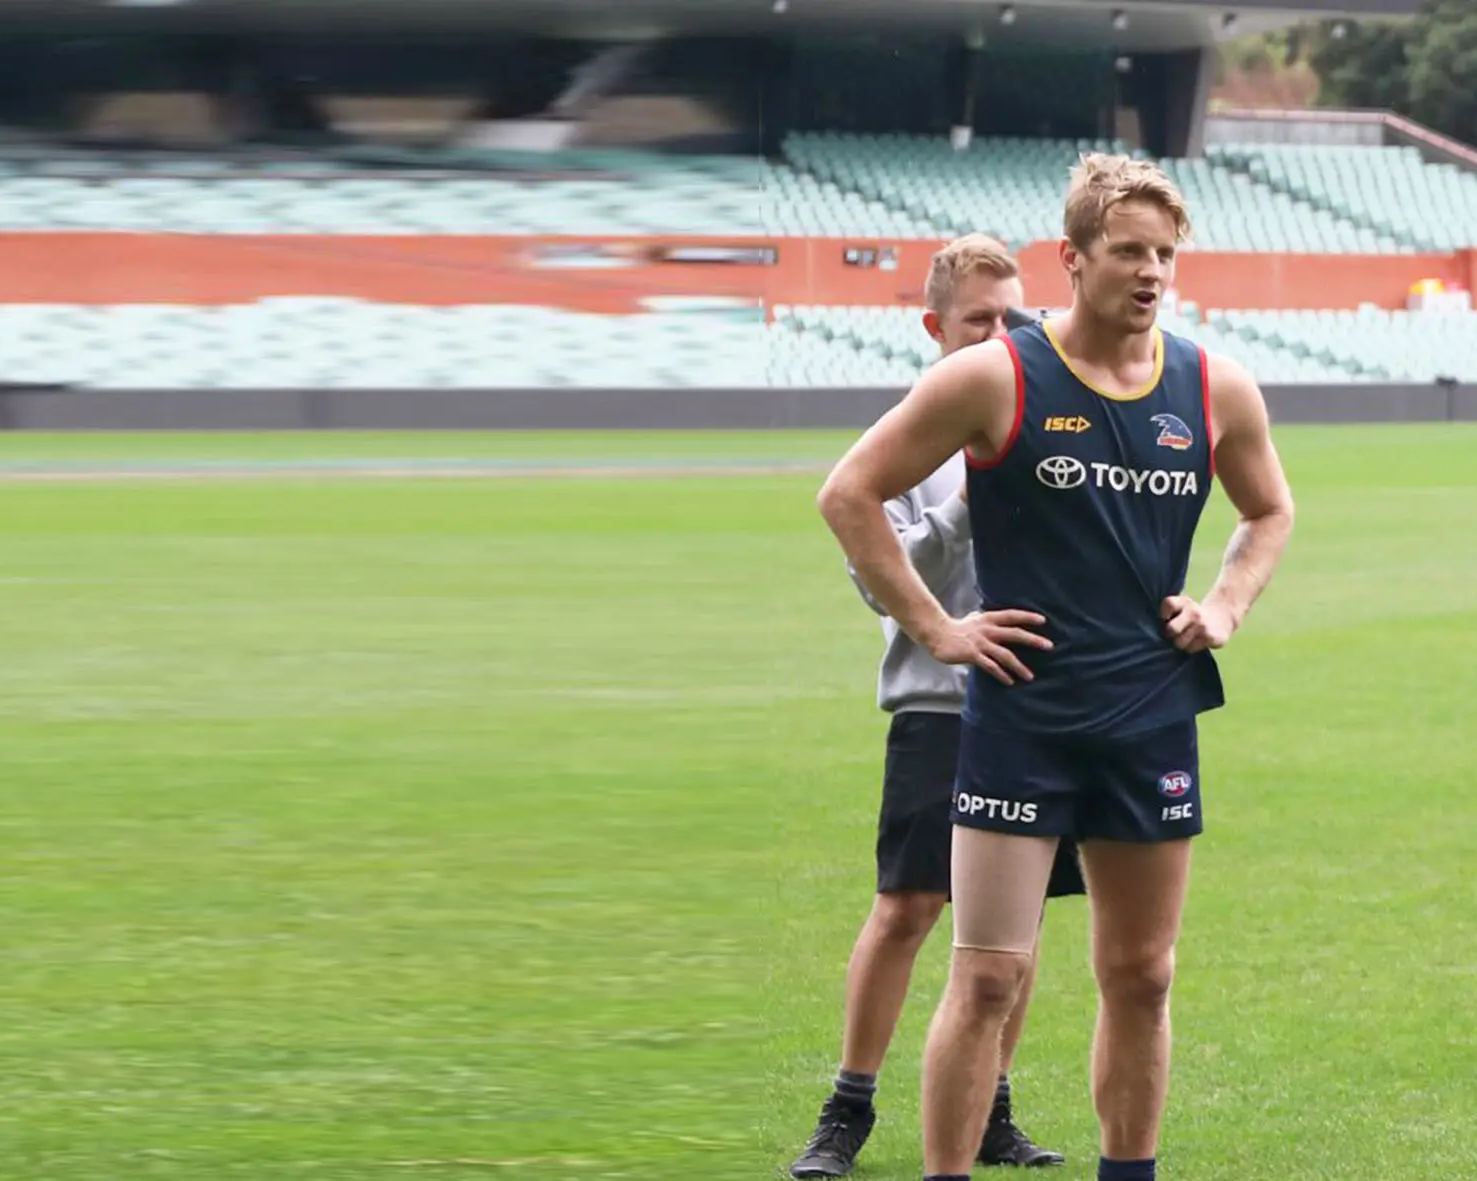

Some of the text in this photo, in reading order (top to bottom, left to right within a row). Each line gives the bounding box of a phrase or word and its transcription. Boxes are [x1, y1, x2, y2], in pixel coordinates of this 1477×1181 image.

[1091, 462, 1197, 496] TOYOTA
[1162, 776, 1191, 792] AFL
[957, 793, 1038, 823] OPTUS
[1161, 803, 1193, 821] ISC
